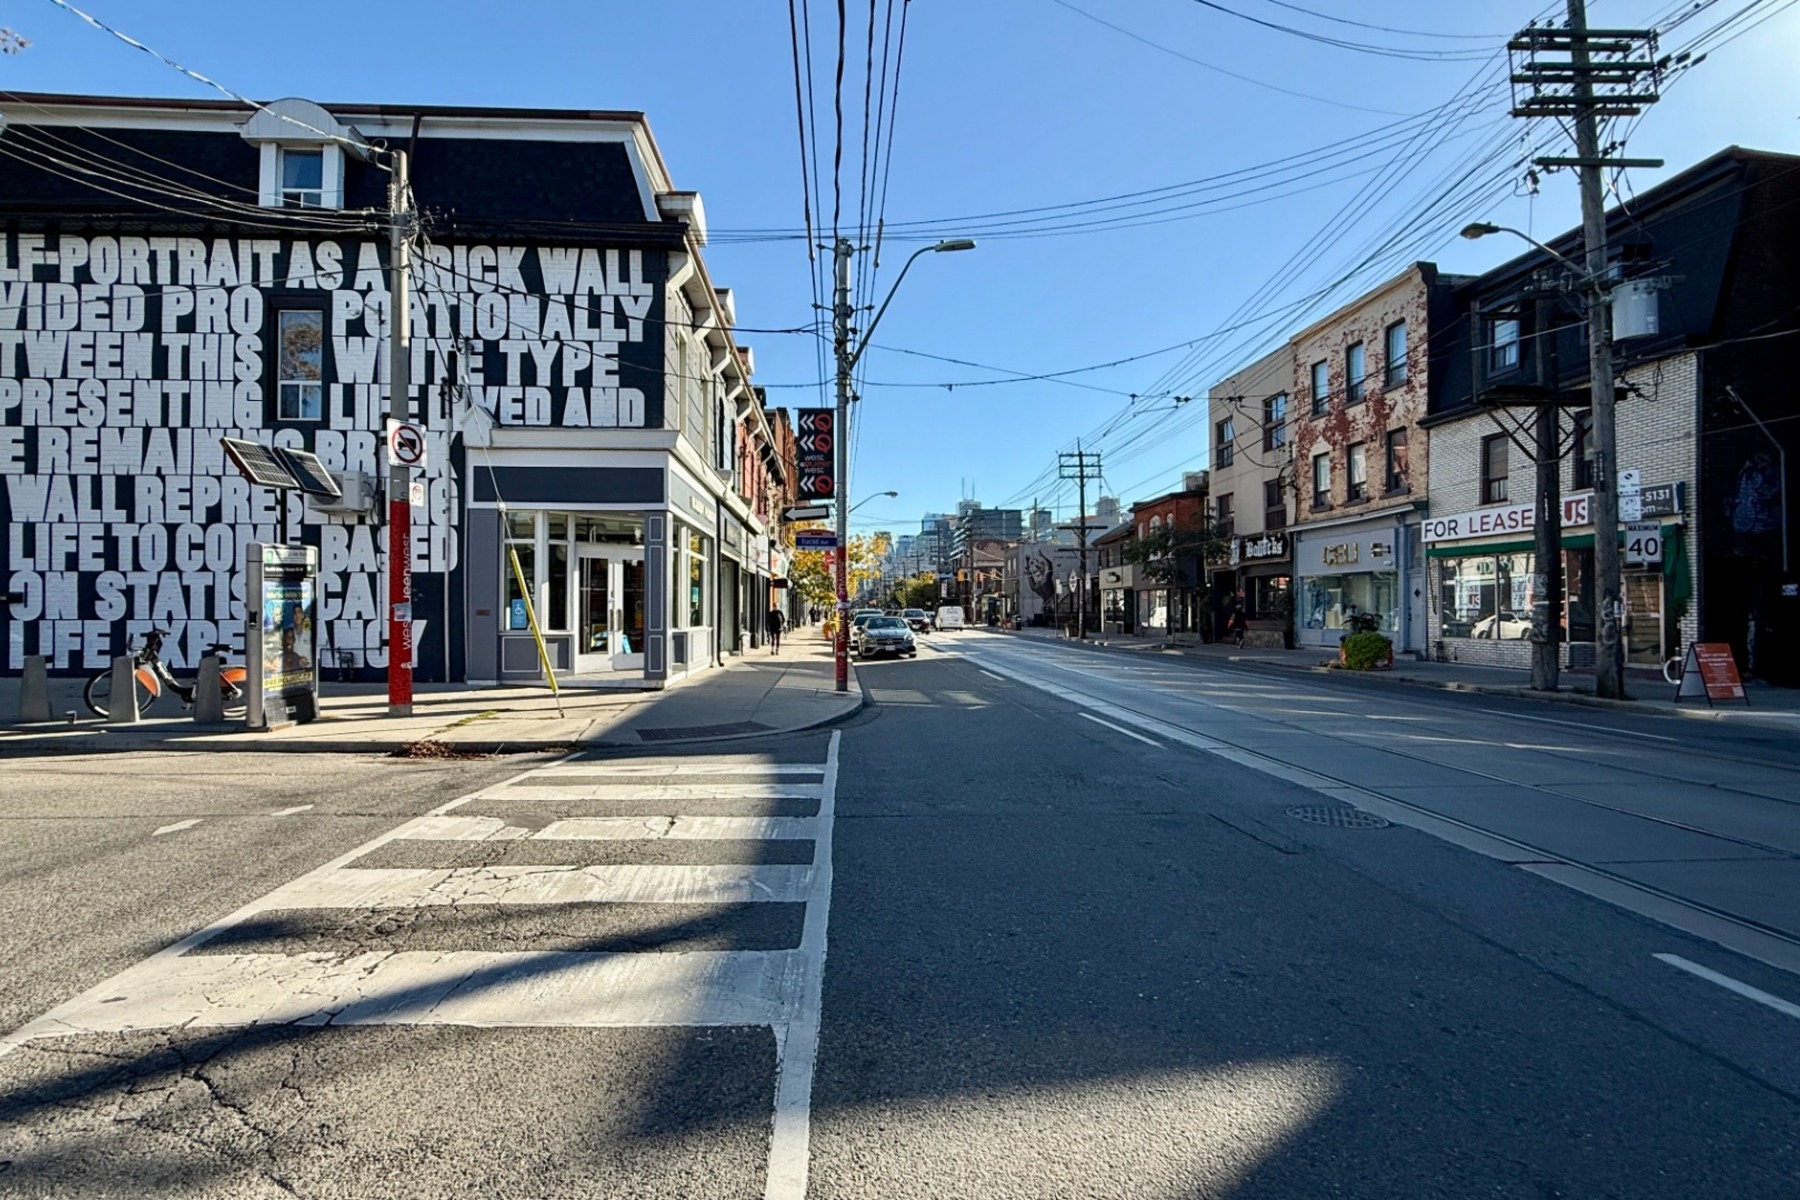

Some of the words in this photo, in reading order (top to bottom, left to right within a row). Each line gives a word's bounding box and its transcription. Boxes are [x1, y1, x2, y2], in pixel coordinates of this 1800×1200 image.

[285, 240, 344, 290] AS
[353, 242, 386, 290] A
[537, 248, 654, 296] WALL
[161, 285, 263, 335] PRO
[161, 333, 263, 382] THIS
[499, 340, 620, 388] TYPE
[562, 387, 645, 428] AND
[315, 430, 458, 479] BRK
[6, 475, 128, 522] WALL
[9, 522, 105, 571] LIFE
[112, 522, 167, 572] TO
[1424, 519, 1458, 539] FOR
[1468, 509, 1534, 535] LEASE
[1628, 538, 1658, 556] 40
[9, 570, 78, 621] ON
[9, 620, 111, 668] LIFE
